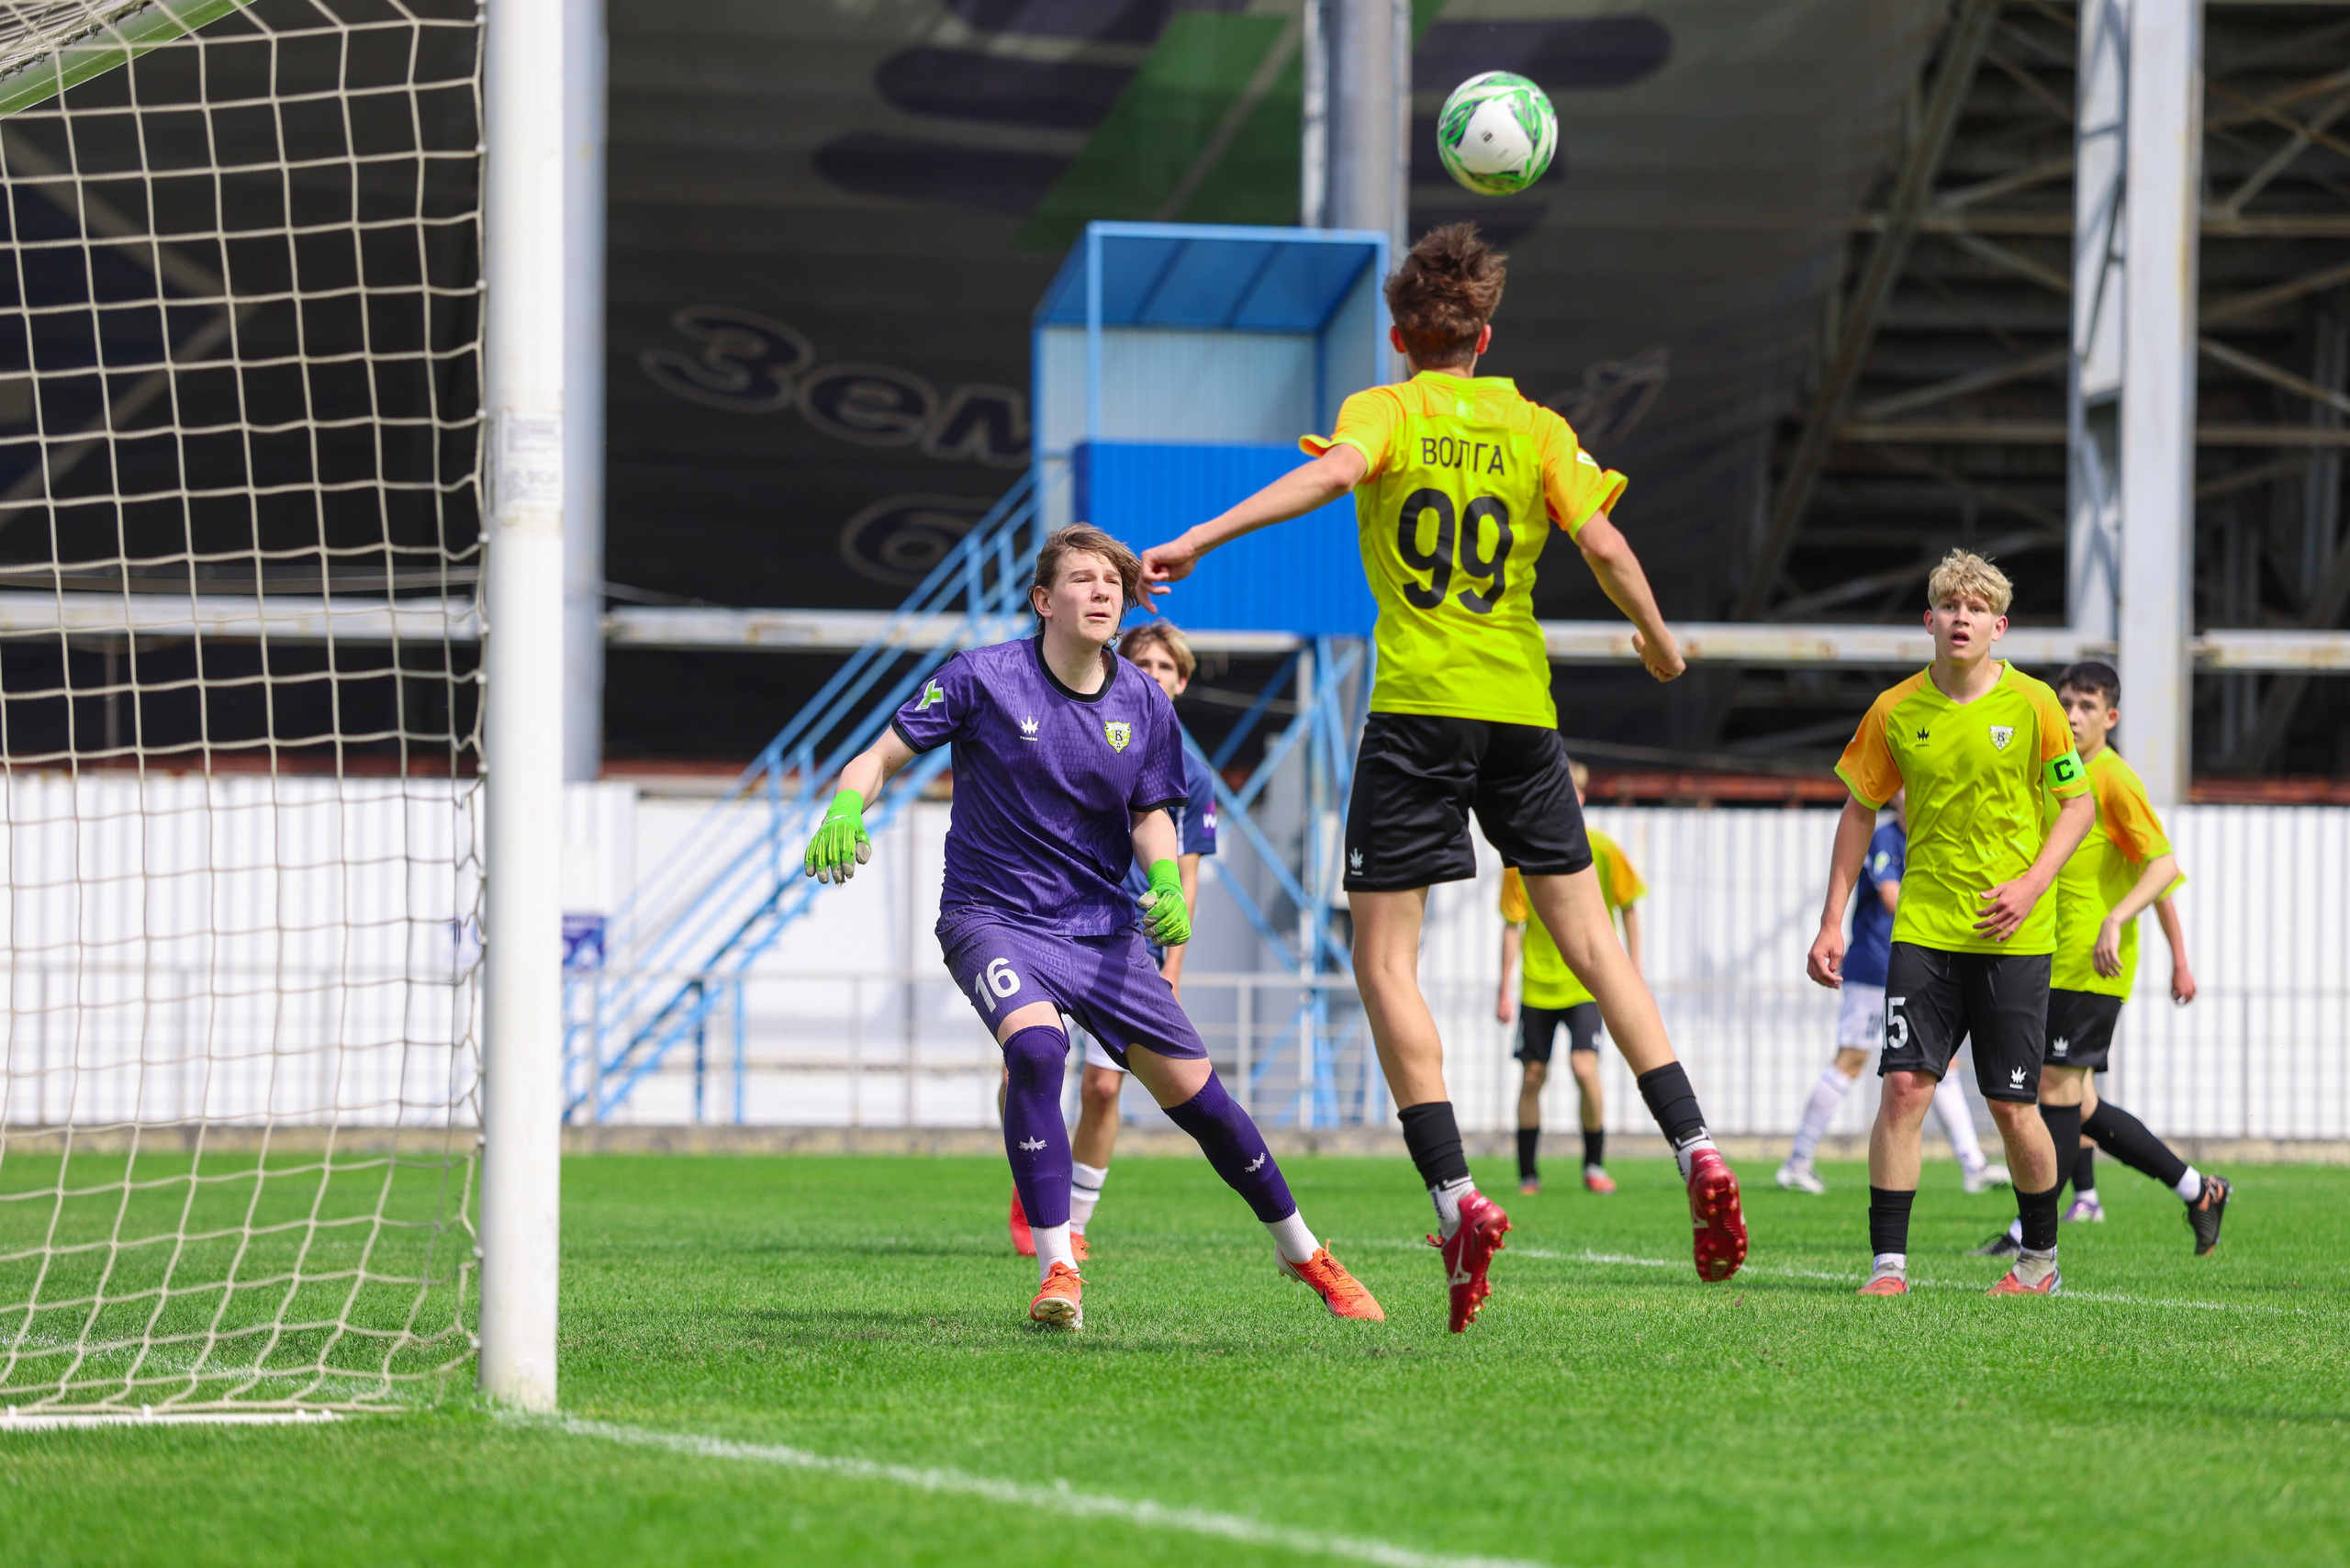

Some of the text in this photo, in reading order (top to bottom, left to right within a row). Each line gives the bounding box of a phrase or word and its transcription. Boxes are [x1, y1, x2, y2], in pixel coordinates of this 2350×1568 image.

[1420, 435, 1505, 476] ВОЛГА
[1397, 487, 1514, 614] 99
[2053, 759, 2075, 782] C
[975, 958, 1021, 1014] 16
